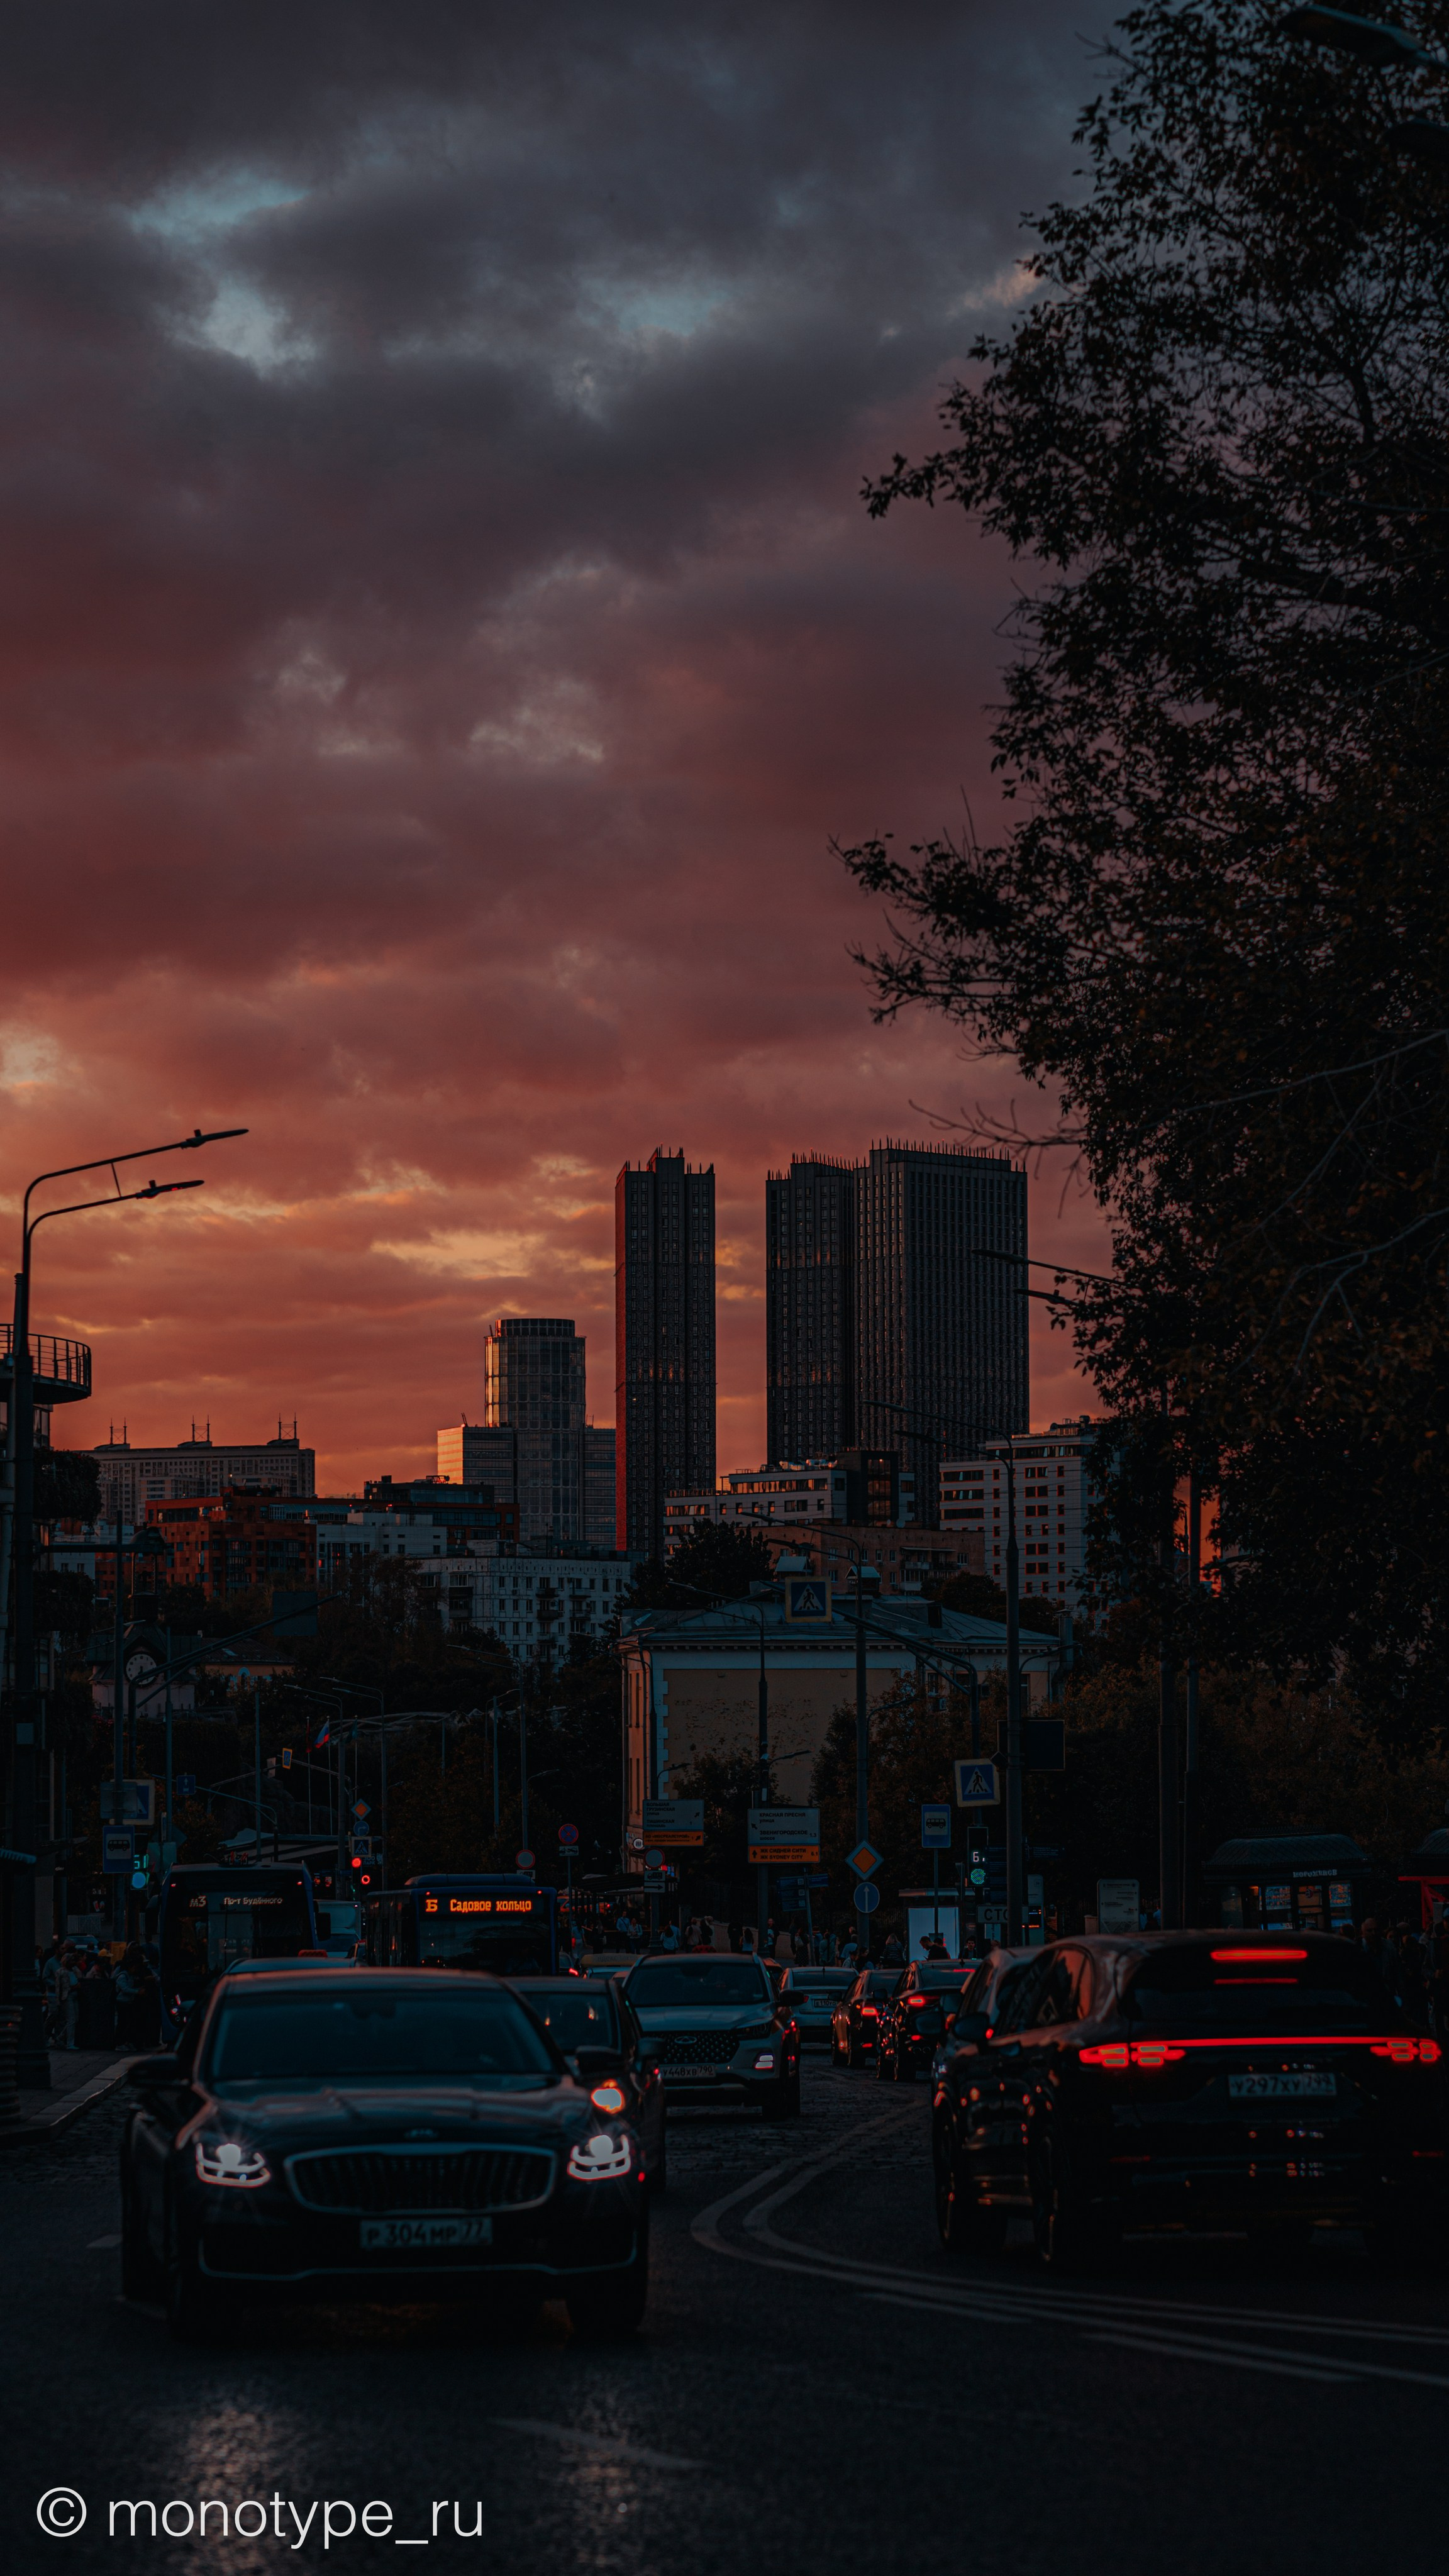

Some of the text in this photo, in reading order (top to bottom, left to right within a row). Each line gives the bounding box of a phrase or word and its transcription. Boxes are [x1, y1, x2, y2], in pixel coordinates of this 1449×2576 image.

[425, 1898, 532, 1914] Б Садовое кольцо
